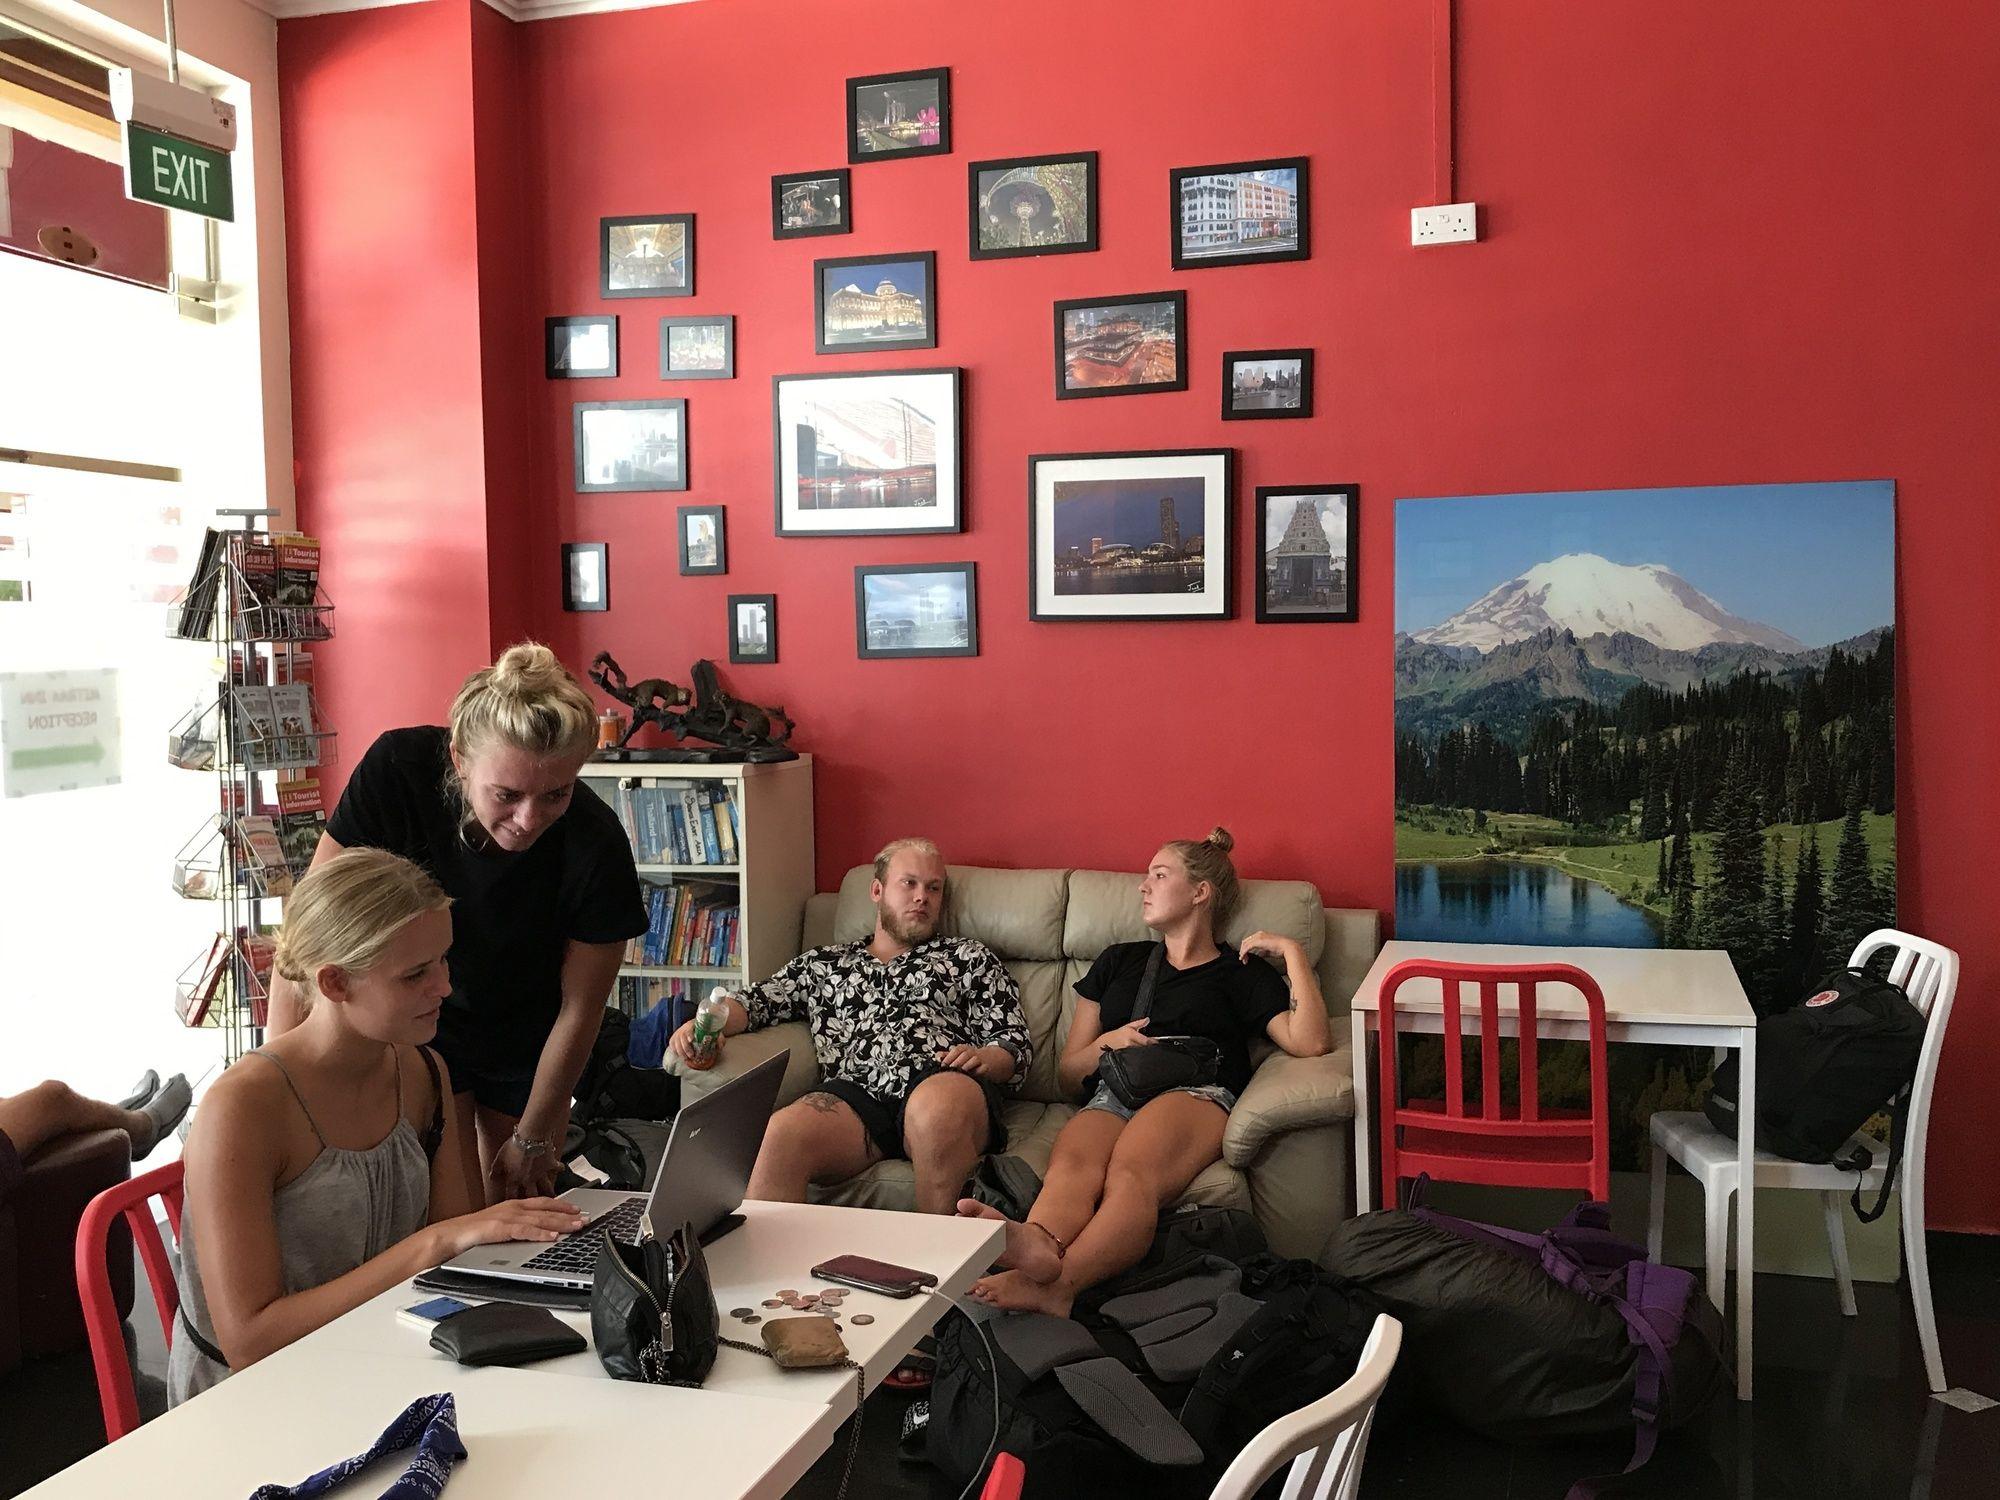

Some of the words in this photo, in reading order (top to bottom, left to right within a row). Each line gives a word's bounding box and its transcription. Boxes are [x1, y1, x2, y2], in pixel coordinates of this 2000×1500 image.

[152, 146, 210, 204] EXIT
[294, 548, 319, 558] Tourist
[292, 790, 321, 800] Tourist
